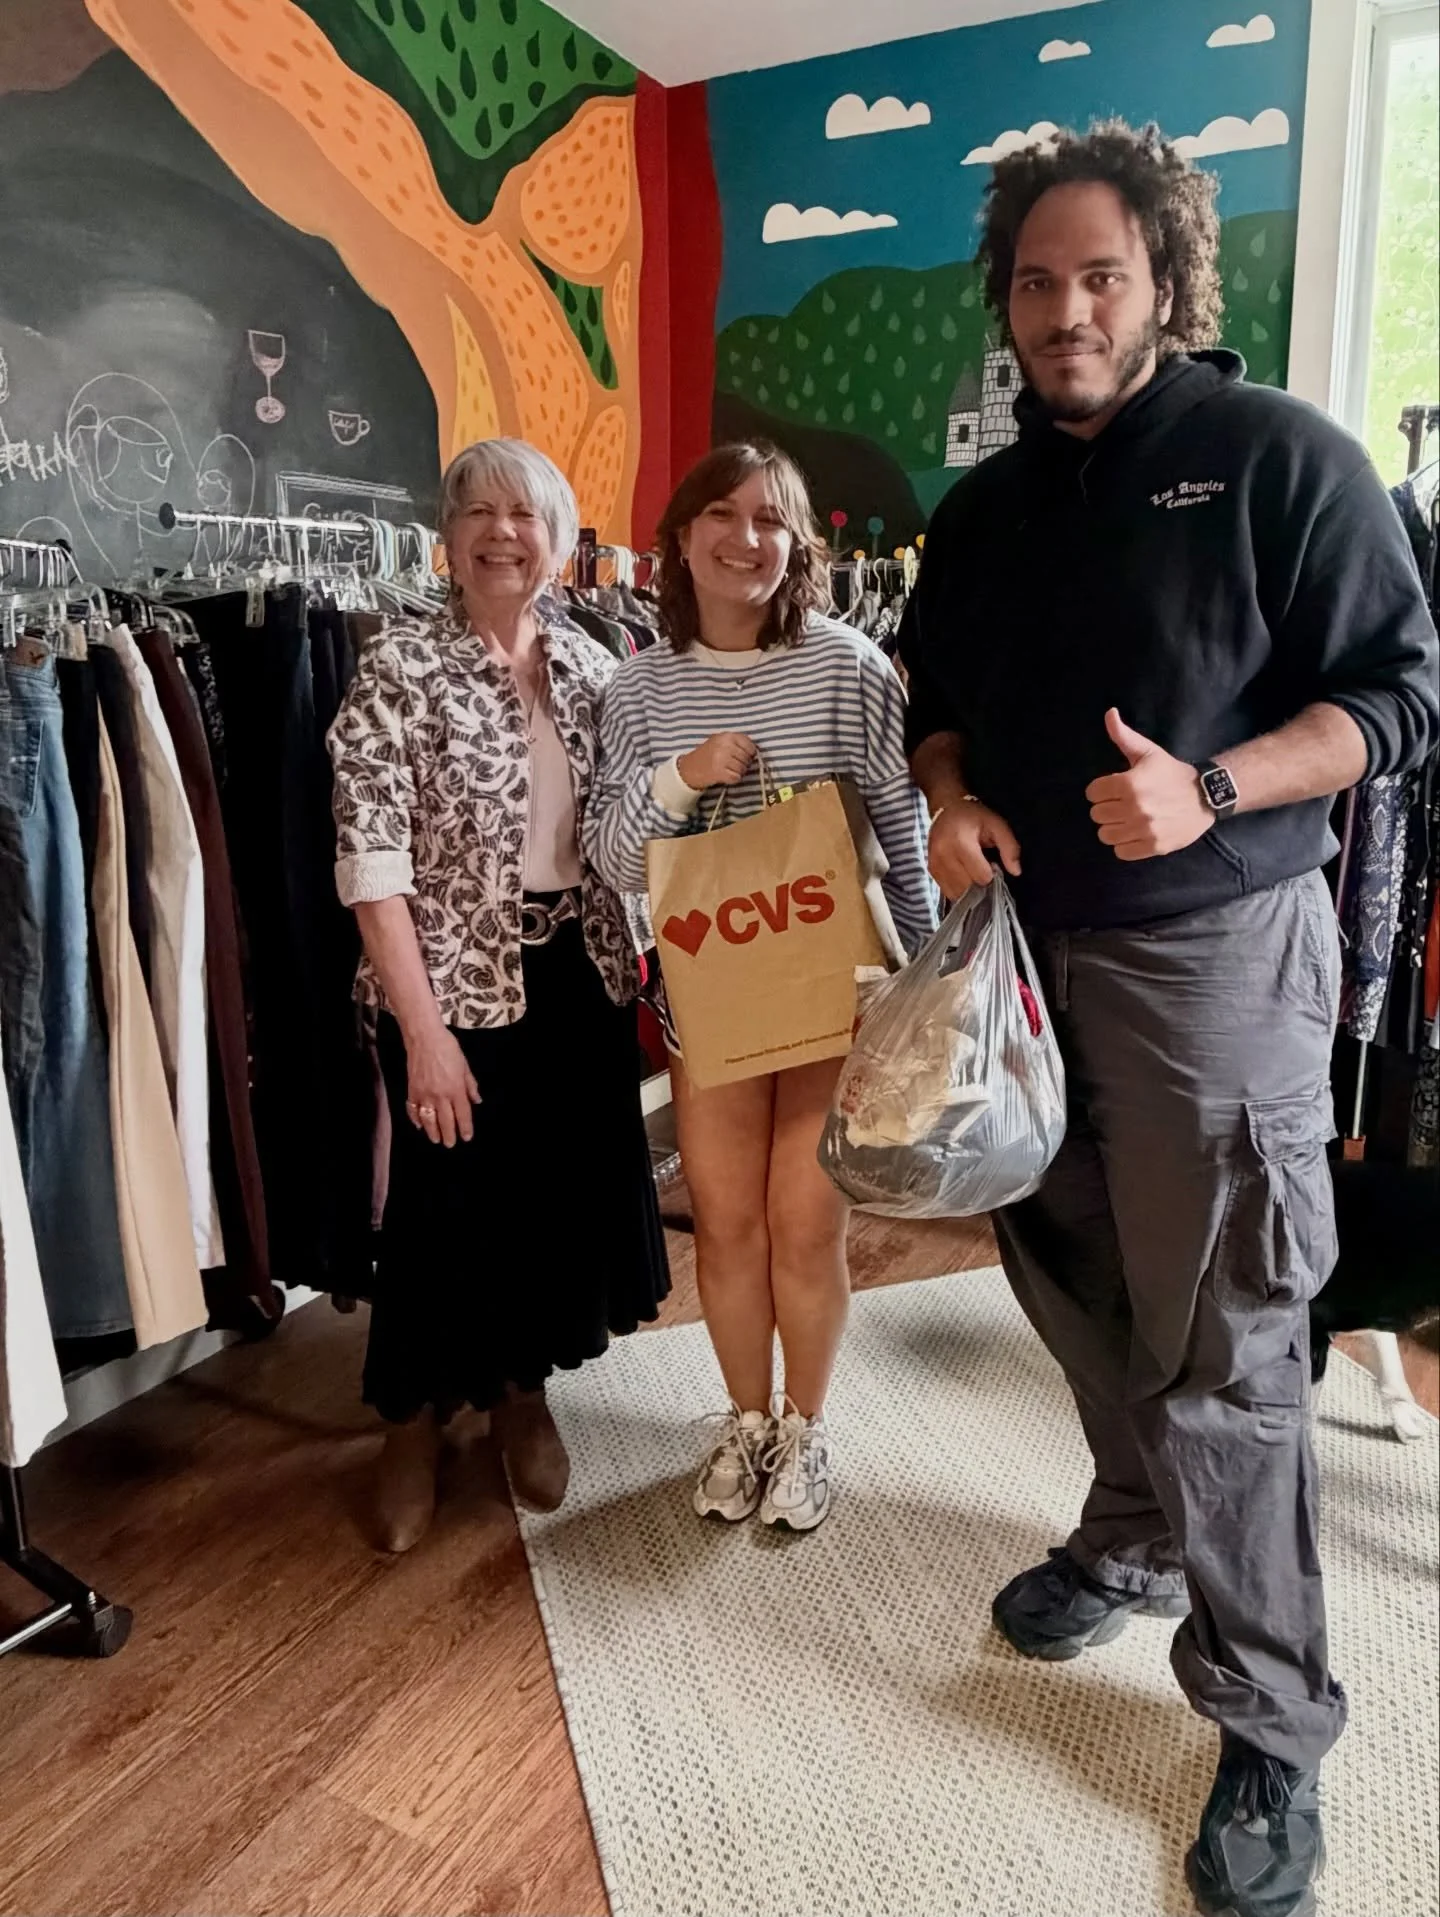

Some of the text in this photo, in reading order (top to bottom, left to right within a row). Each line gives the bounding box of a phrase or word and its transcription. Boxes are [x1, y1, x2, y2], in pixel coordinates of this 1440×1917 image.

[1150, 480, 1225, 506] Los Angeles
[1166, 494, 1210, 508] California
[716, 874, 835, 945] CVS
